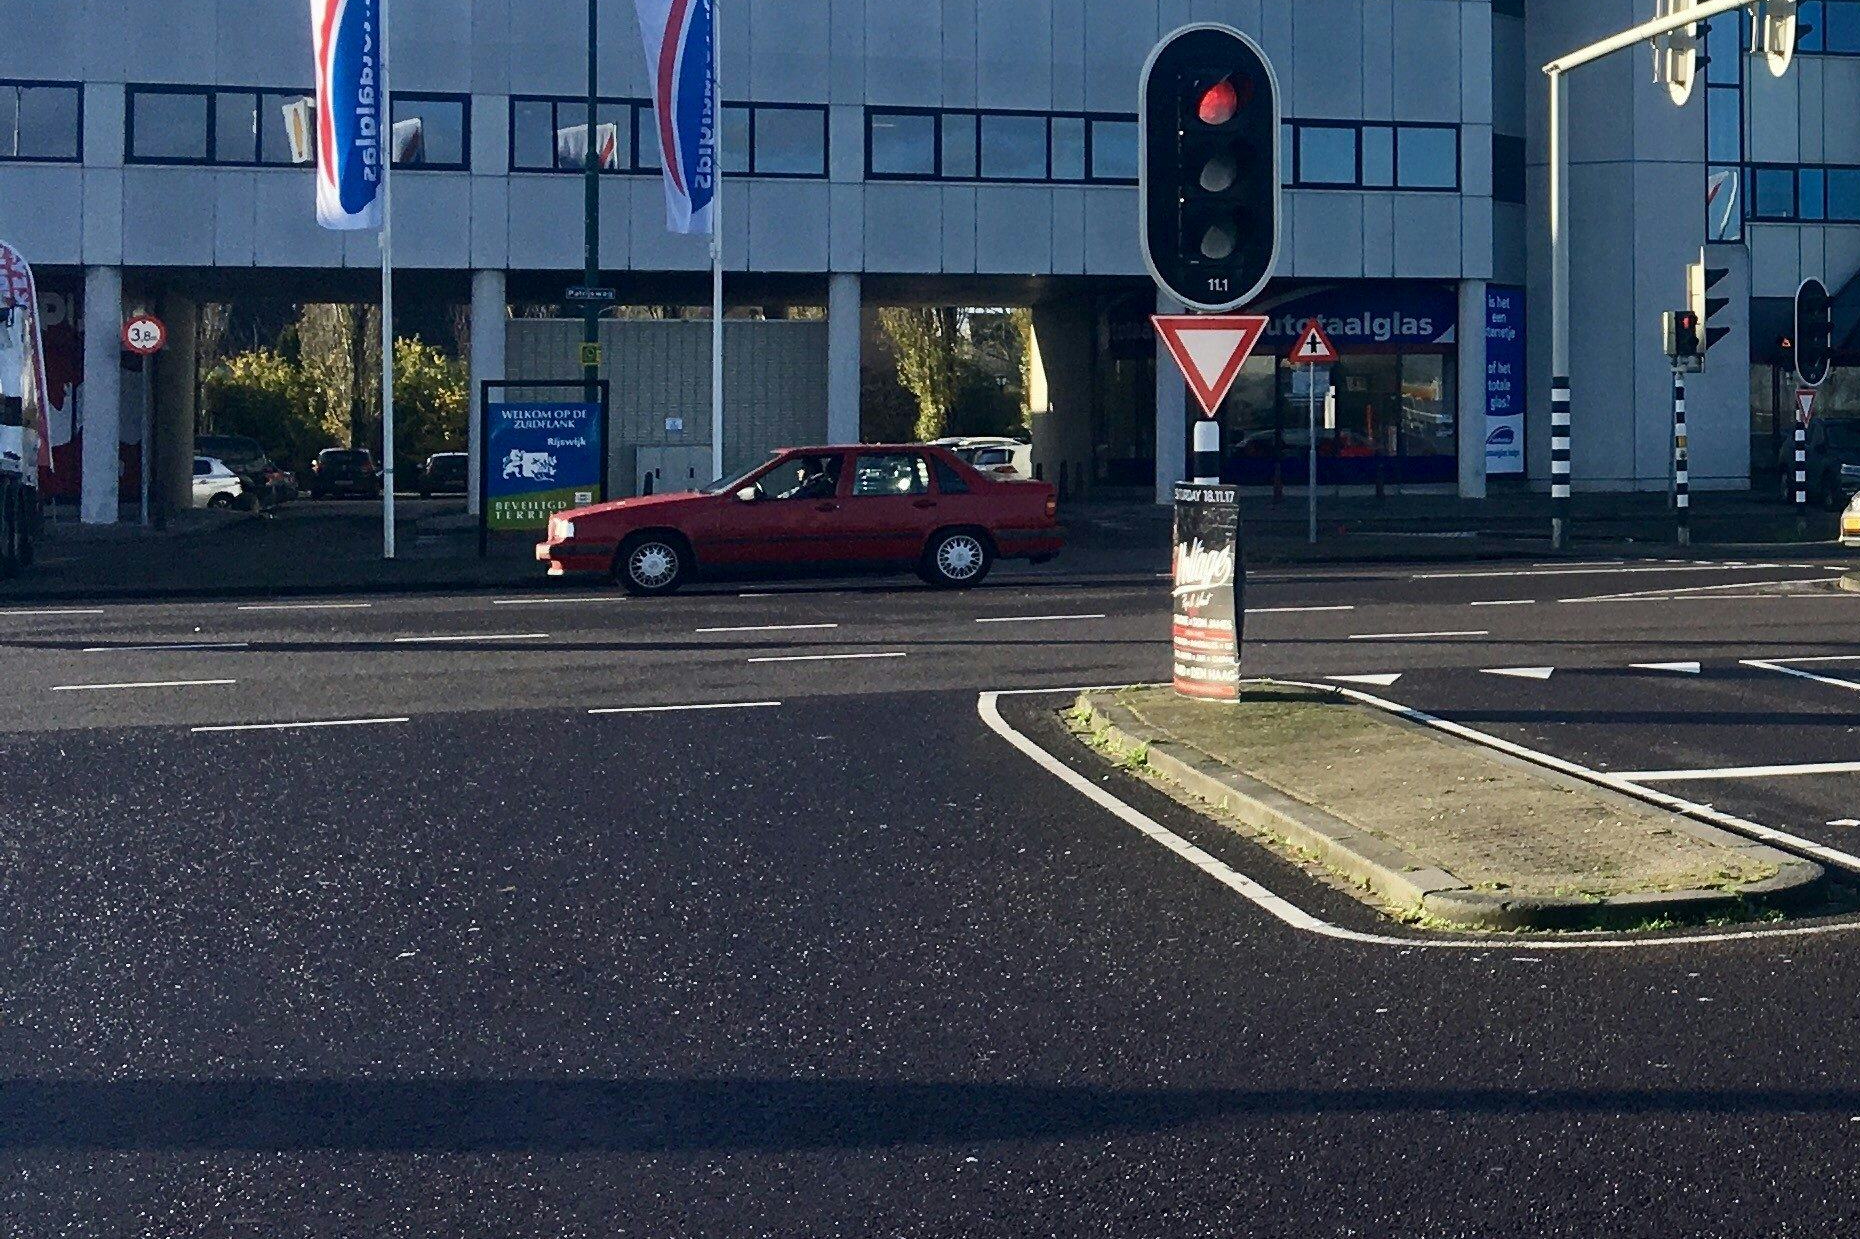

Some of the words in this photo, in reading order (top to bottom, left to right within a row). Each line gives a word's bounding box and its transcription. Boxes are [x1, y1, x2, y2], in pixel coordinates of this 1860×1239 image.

[1207, 278, 1228, 292] 11.1
[1265, 311, 1433, 341] utotaalglas
[501, 409, 552, 420] WELKOM
[554, 409, 571, 419] OP
[573, 409, 587, 419] DE
[547, 436, 587, 448] Rijswijk
[495, 500, 568, 510] BEVEILIGD
